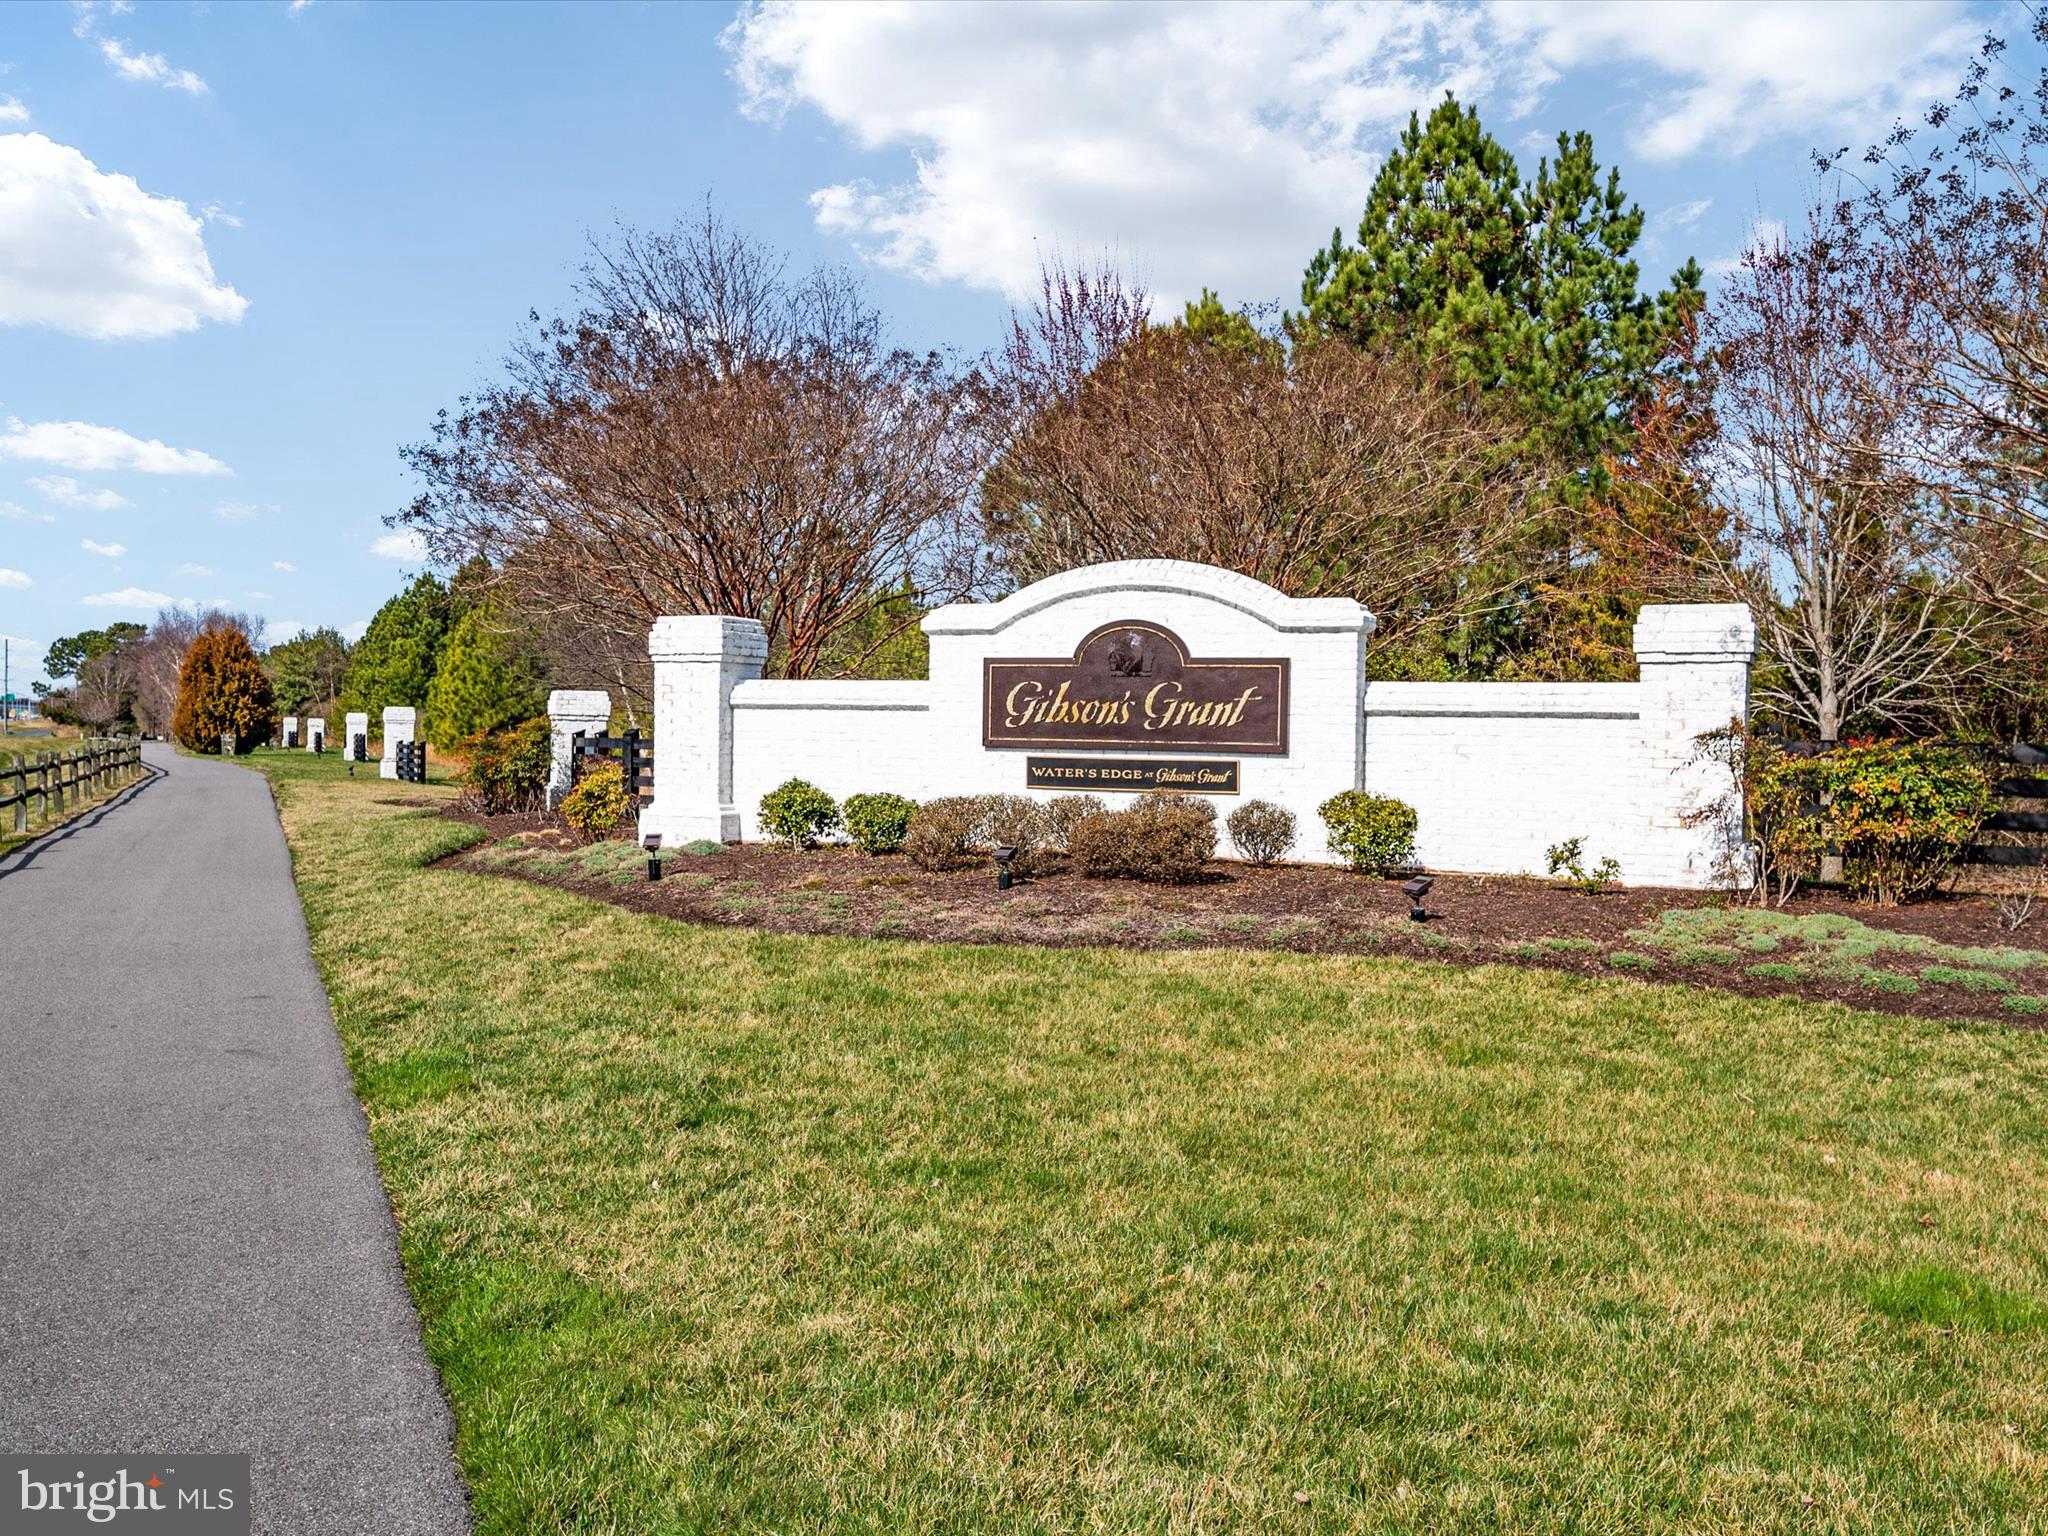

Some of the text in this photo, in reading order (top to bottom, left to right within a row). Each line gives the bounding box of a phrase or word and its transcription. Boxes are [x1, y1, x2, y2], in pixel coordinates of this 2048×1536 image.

[1005, 680, 1262, 730] Gibson's Grant
[1032, 766, 1097, 779] WATER'S
[1101, 769, 1143, 780] EDGE
[1156, 770, 1196, 784] Gibson's
[1197, 771, 1233, 784] Grant
